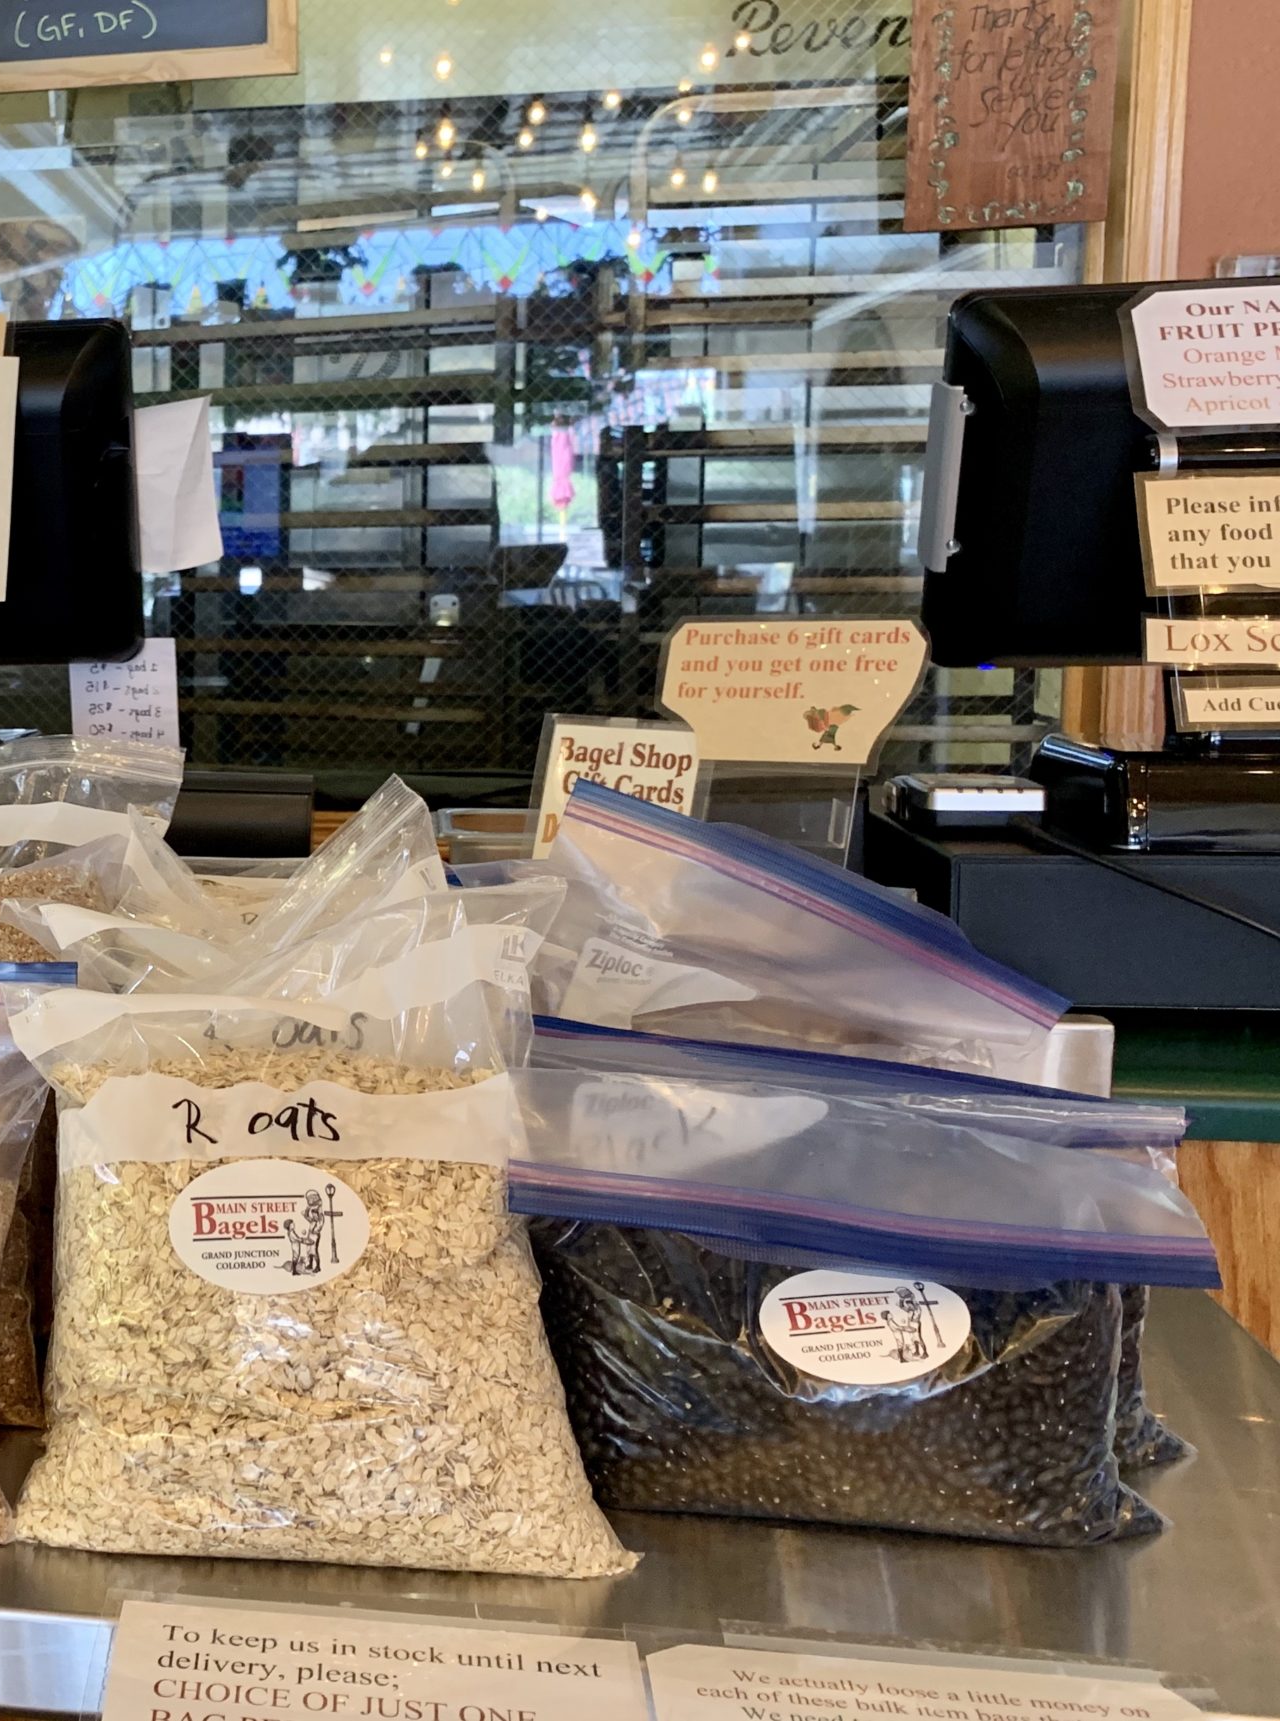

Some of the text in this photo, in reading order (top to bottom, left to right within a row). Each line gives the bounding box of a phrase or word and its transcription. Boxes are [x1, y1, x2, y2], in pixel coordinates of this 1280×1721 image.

[726, 0, 912, 57] Reven
[951, 40, 992, 80] for
[1186, 303, 1235, 317] Our
[1159, 323, 1244, 341] FRUIT
[1184, 348, 1266, 366] Orange
[1186, 395, 1271, 416] Apricot
[1166, 498, 1241, 514] Please
[1168, 523, 1273, 546] any food
[1170, 553, 1272, 573] that you
[686, 626, 910, 648] Purchase 6 gift cards
[1165, 625, 1233, 652] Lox
[681, 654, 898, 677] and you get one free
[678, 682, 805, 703] for yourself.
[1204, 698, 1241, 712] Add
[560, 737, 693, 777] Bagel Shop
[585, 948, 644, 978] Ziploc
[172, 1097, 340, 1144] R oats
[216, 1201, 298, 1214] MAIN STREET
[192, 1202, 279, 1240] Bagels
[201, 1249, 280, 1260] GRAND JUNCTION
[216, 1260, 266, 1271] COLORADO
[808, 1296, 890, 1311] MAIN STREET
[782, 1301, 877, 1333] Bagels
[801, 1339, 883, 1353] GRAND JUNCTION
[818, 1351, 871, 1362] COLORADO
[162, 1624, 602, 1678] To keep us in stock until next
[157, 1651, 399, 1690] delivery, please;
[153, 1678, 292, 1709] CHOICE
[302, 1692, 350, 1713] OF
[360, 1696, 448, 1721] JUST
[732, 1670, 1150, 1719] We actually loose a little money on
